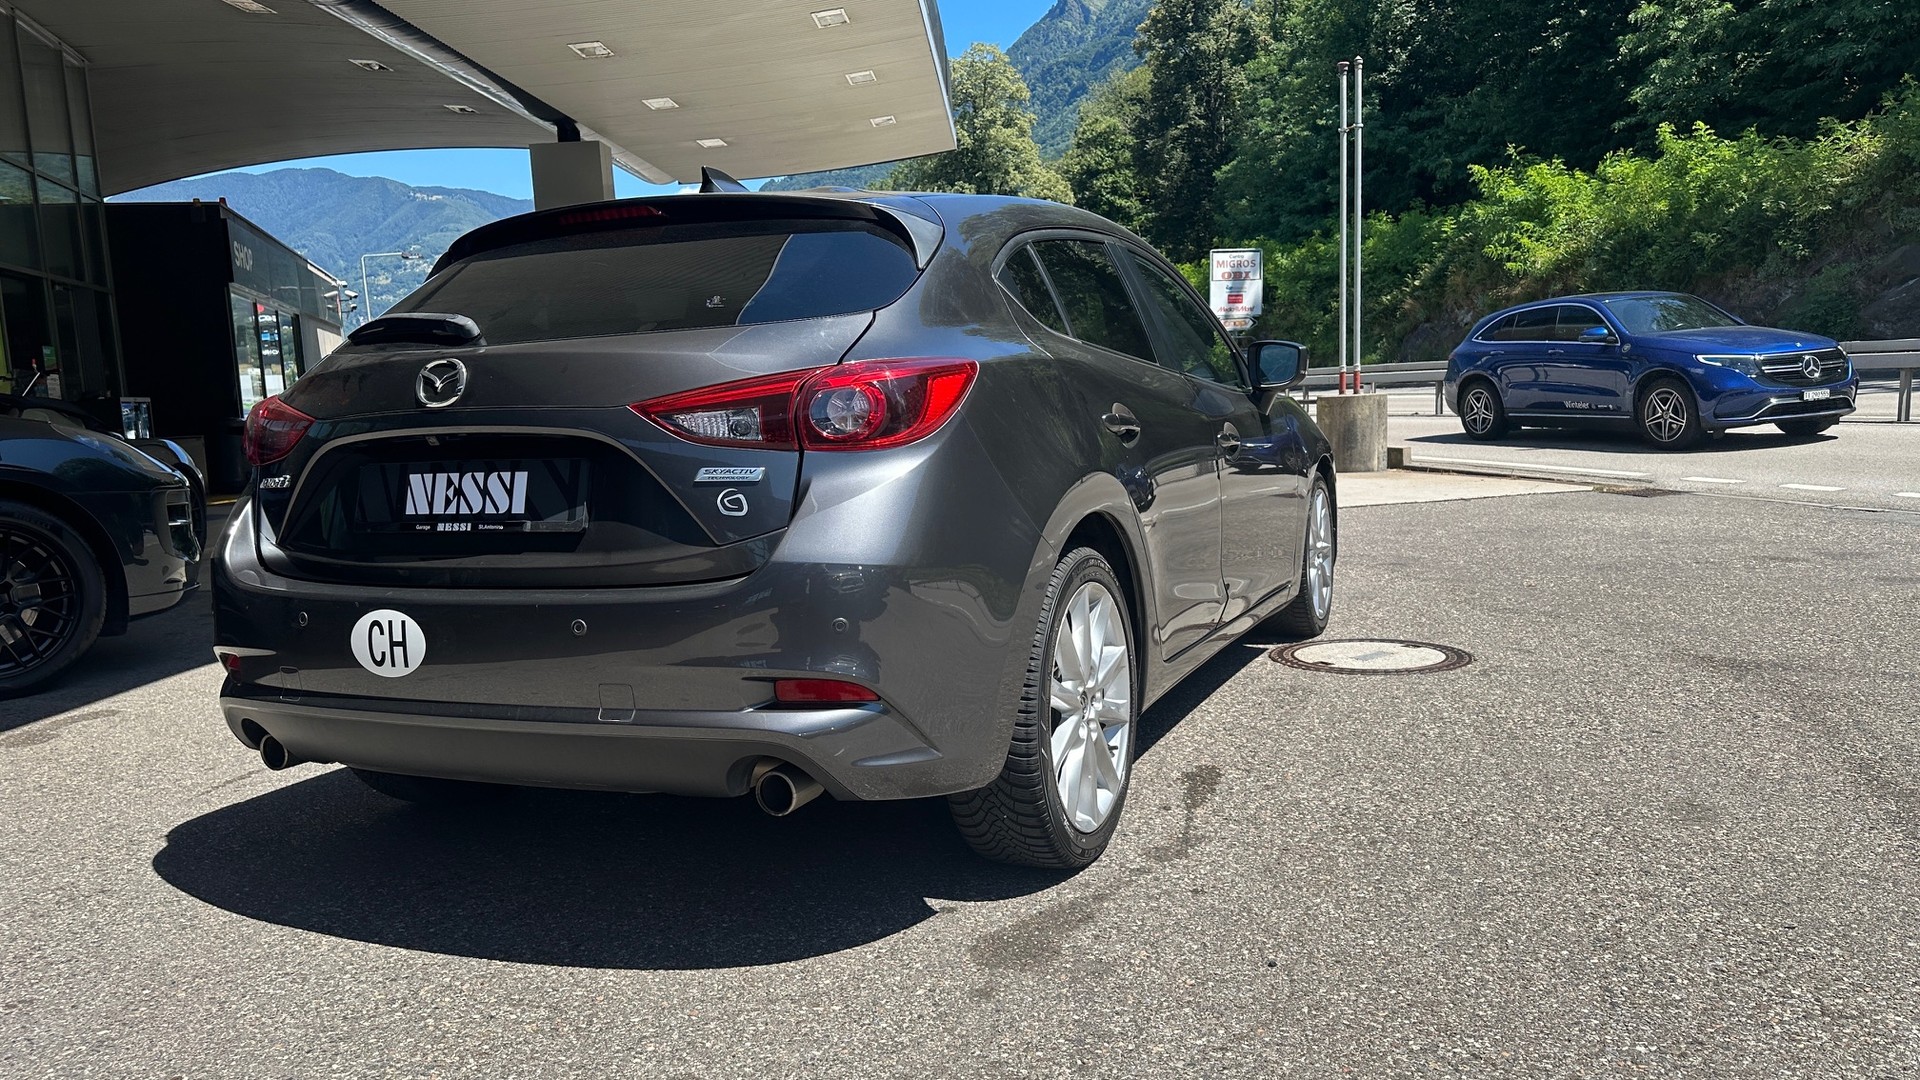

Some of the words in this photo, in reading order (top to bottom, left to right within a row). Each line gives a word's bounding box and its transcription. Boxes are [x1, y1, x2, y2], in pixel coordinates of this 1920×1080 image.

[233, 240, 253, 272] SHOP
[1216, 260, 1256, 268] MIGROS
[405, 471, 529, 515] NESSI
[436, 522, 472, 532] NESSI
[367, 619, 409, 669] CH
